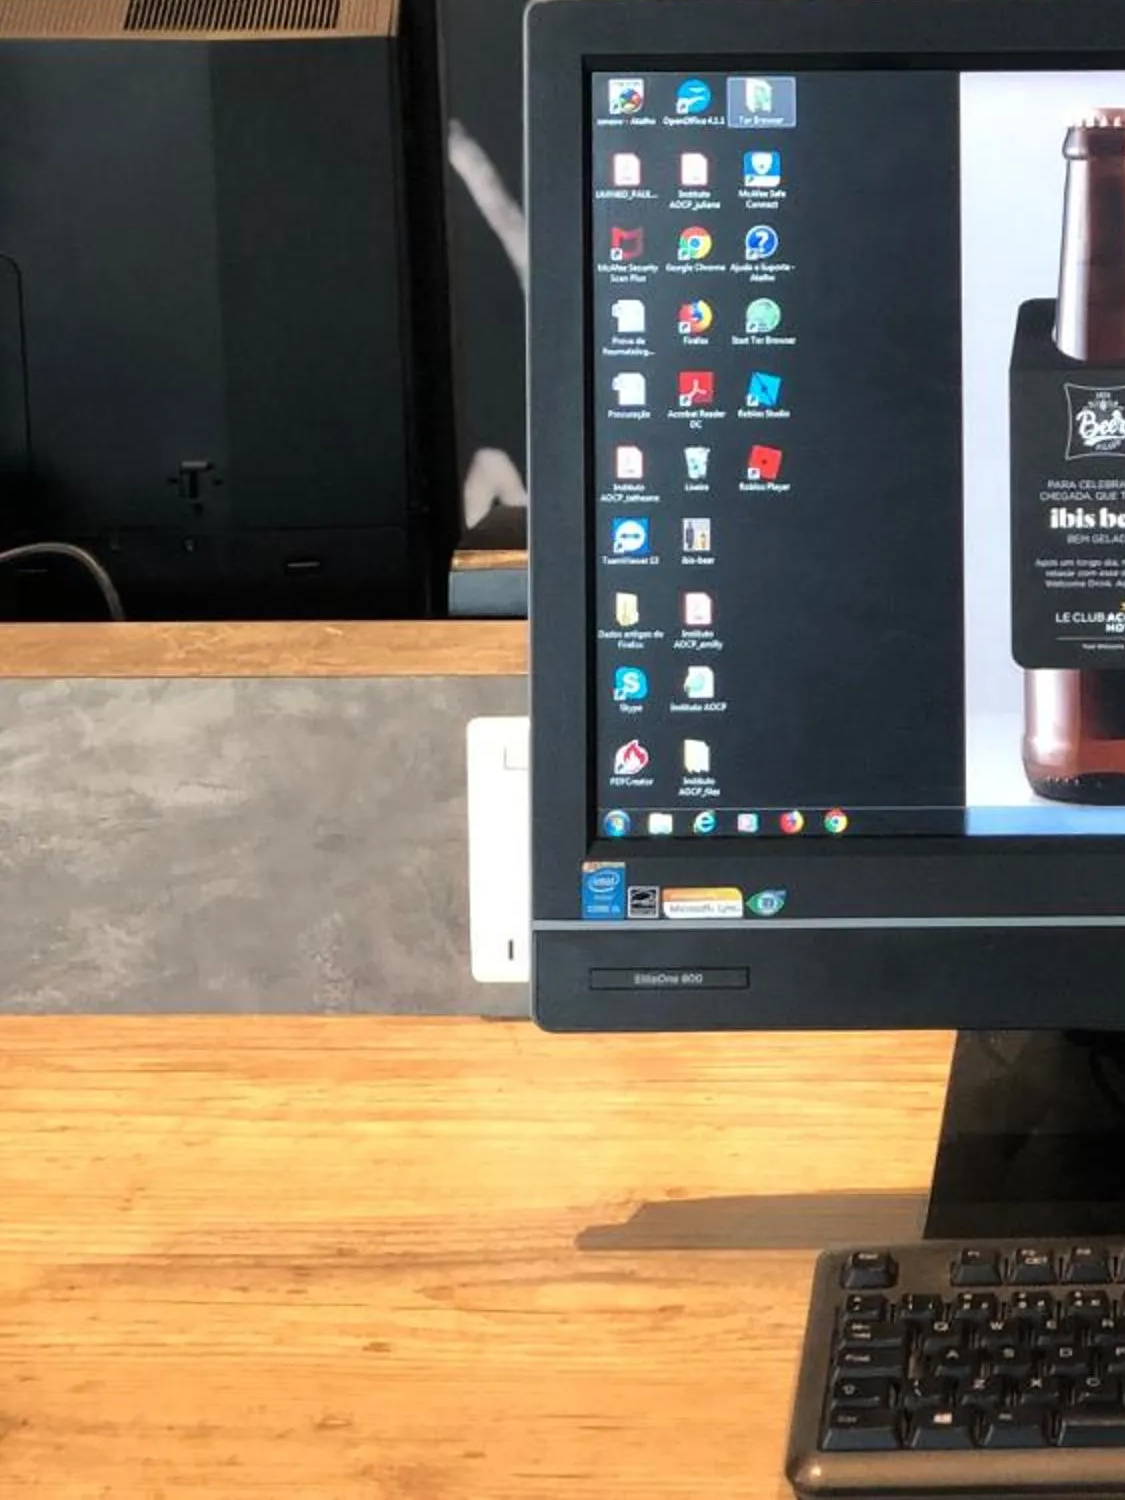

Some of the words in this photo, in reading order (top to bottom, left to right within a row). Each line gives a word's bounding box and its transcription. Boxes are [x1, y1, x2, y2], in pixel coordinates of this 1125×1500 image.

[1048, 480, 1076, 489] PARA
[1095, 492, 1118, 501] QUE
[1050, 507, 1096, 529] ibis
[1055, 612, 1071, 623] LE
[1072, 612, 1105, 623] CLUB
